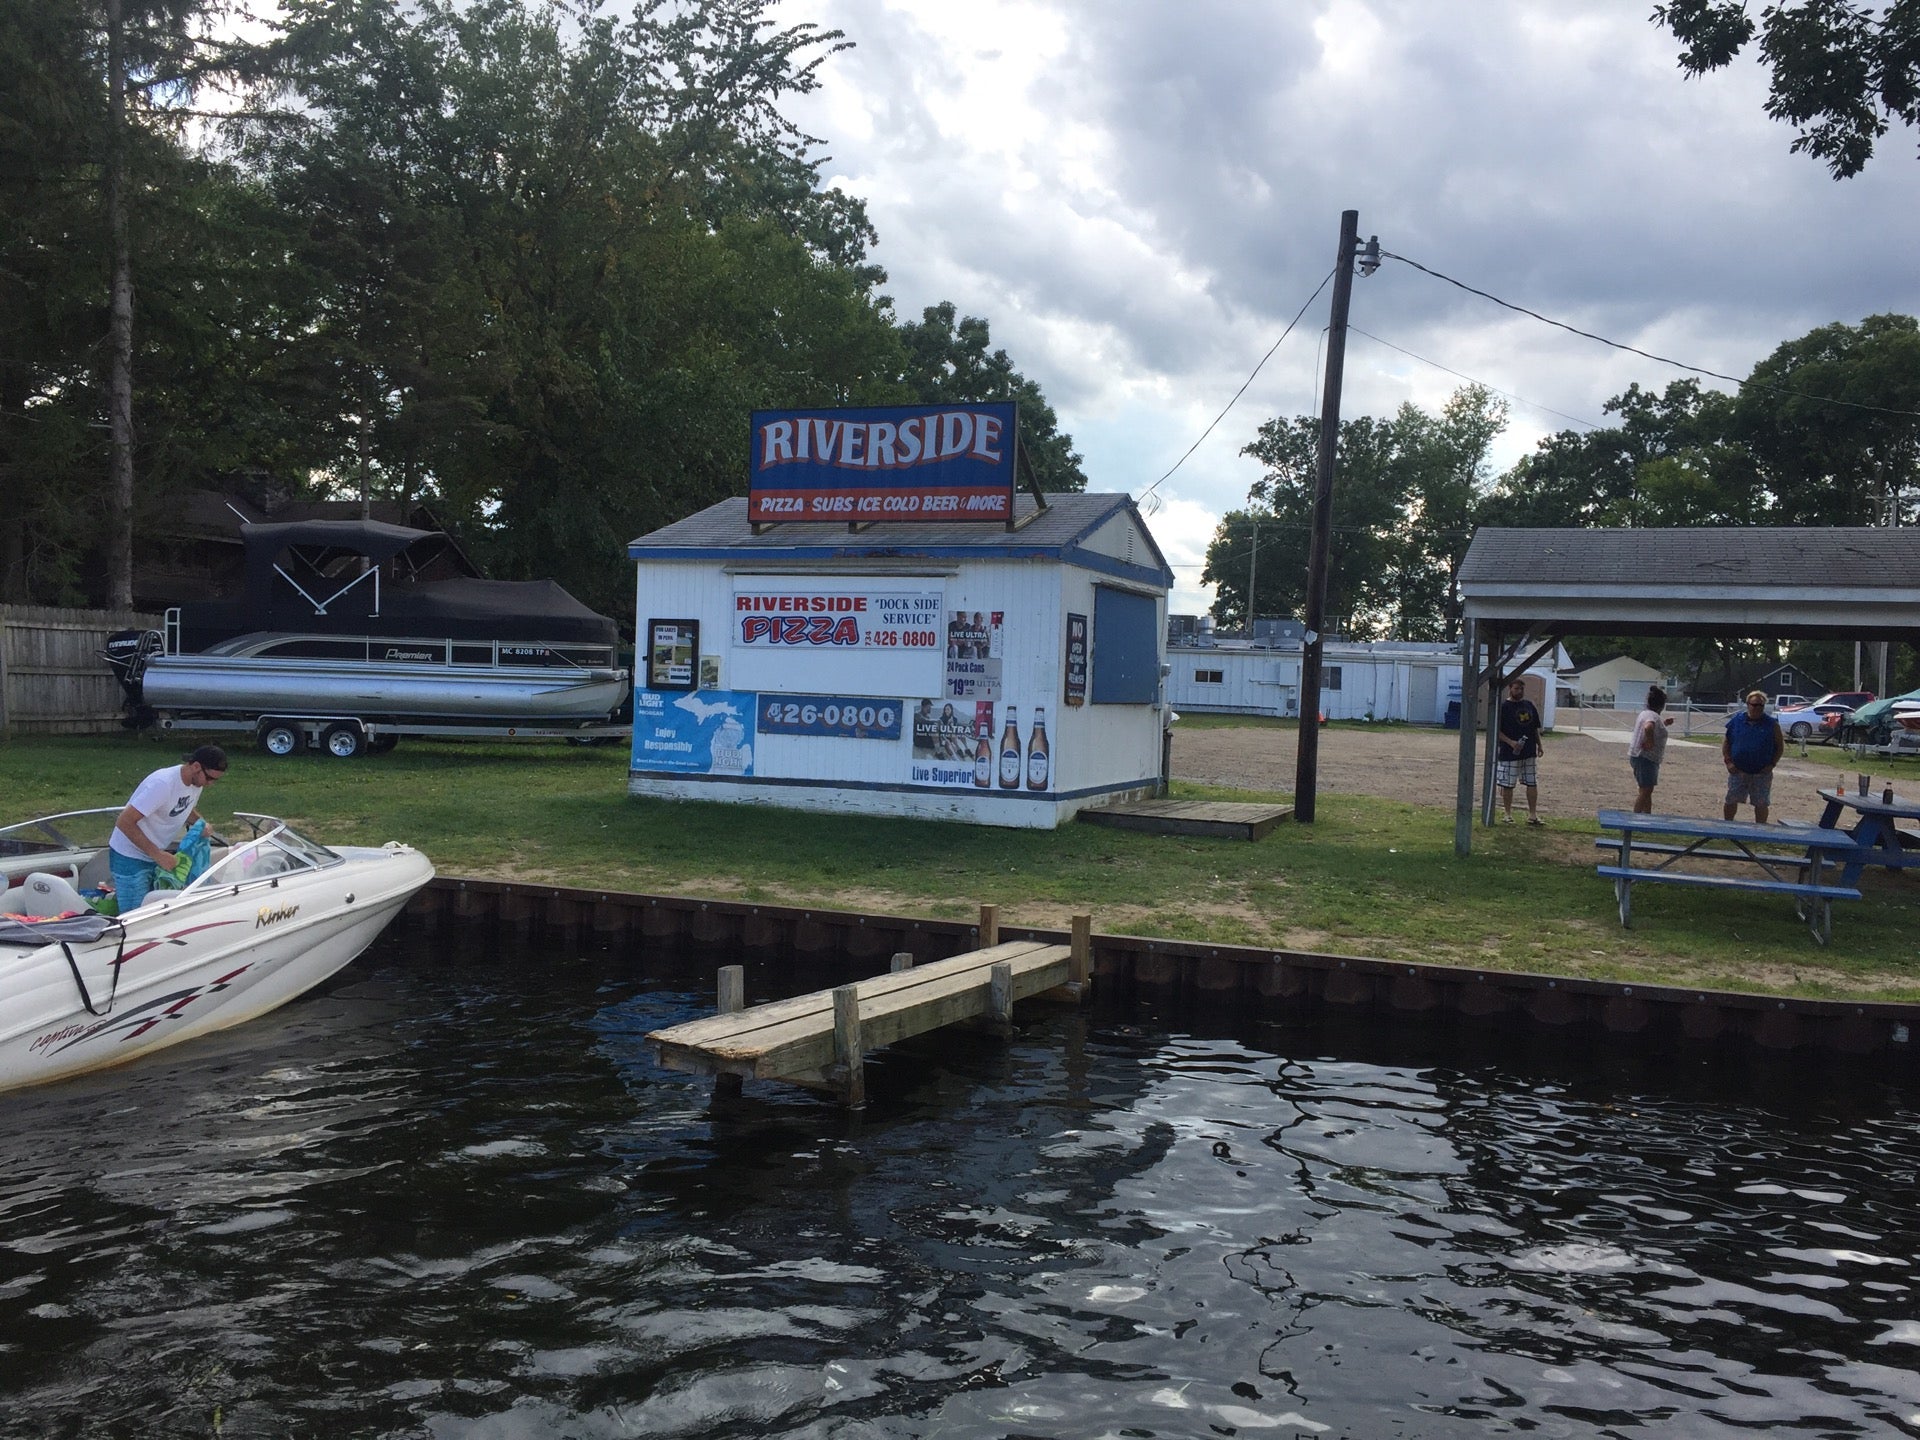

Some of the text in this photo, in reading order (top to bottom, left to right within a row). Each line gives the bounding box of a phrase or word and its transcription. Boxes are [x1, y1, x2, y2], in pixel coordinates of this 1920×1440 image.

[760, 412, 1003, 469] RIVERSIDE
[760, 498, 804, 512] PIZZA
[812, 497, 854, 512] SUBS
[857, 497, 882, 511] ICE
[883, 496, 920, 511] COLD
[922, 495, 959, 511] BEER
[967, 495, 1007, 510] MORE
[737, 597, 867, 612] RIVERSIDE
[913, 599, 940, 610] SIDE
[742, 615, 860, 646] PIZZA
[965, 631, 987, 639] ULTRA
[1072, 621, 1083, 638] NO
[873, 630, 936, 647] 426-0800
[385, 648, 433, 662] Premier
[947, 661, 985, 673] 24 Pack Cans
[977, 680, 1001, 688] ULTRA
[639, 700, 664, 708] LIGHT
[641, 693, 661, 701] BUD
[766, 702, 896, 728] 426-0800
[655, 727, 677, 739] Enjoy
[916, 723, 972, 734] LIVE ULTRA
[644, 739, 693, 753] Responsibly
[912, 766, 975, 785] Live Superior!
[255, 902, 300, 930] Rinker
